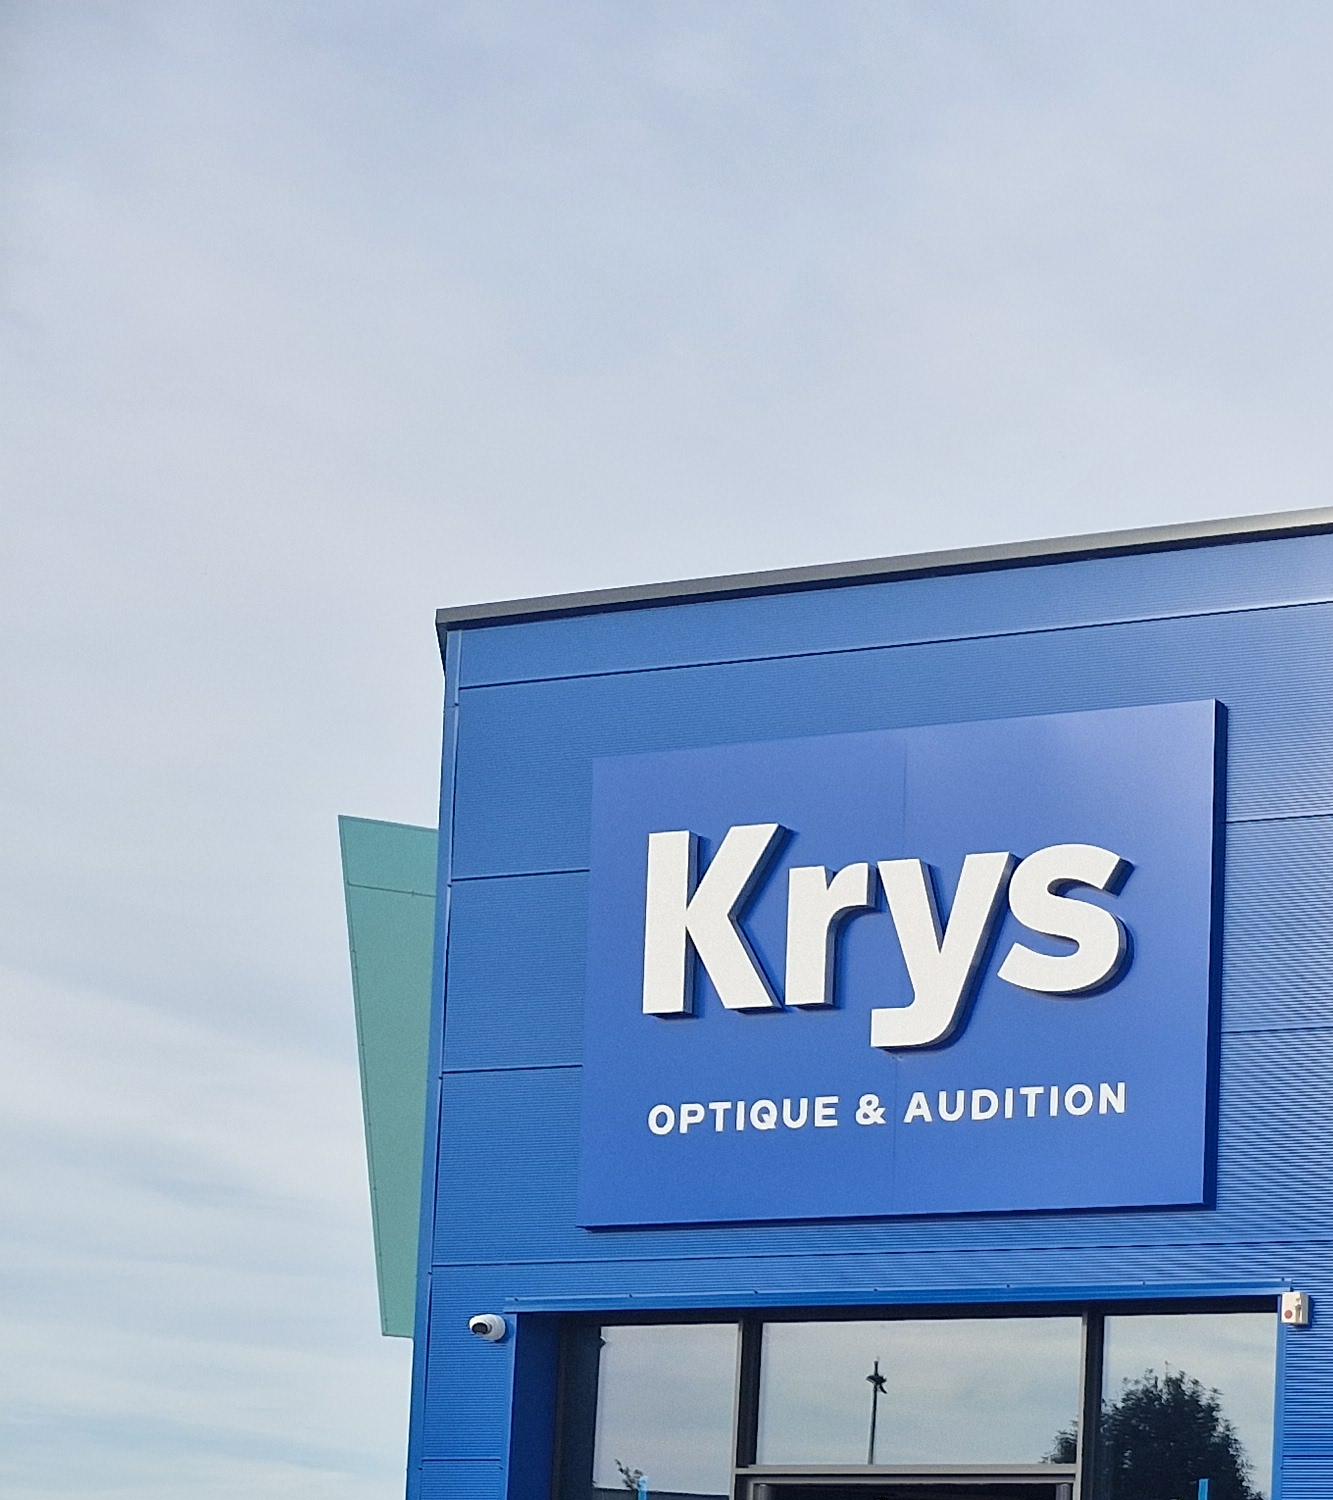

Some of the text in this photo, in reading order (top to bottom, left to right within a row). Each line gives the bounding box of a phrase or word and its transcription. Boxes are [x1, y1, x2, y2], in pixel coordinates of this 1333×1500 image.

[641, 822, 1130, 1050] Krys
[646, 1082, 1127, 1135] OPTIQUE & AUDITION
